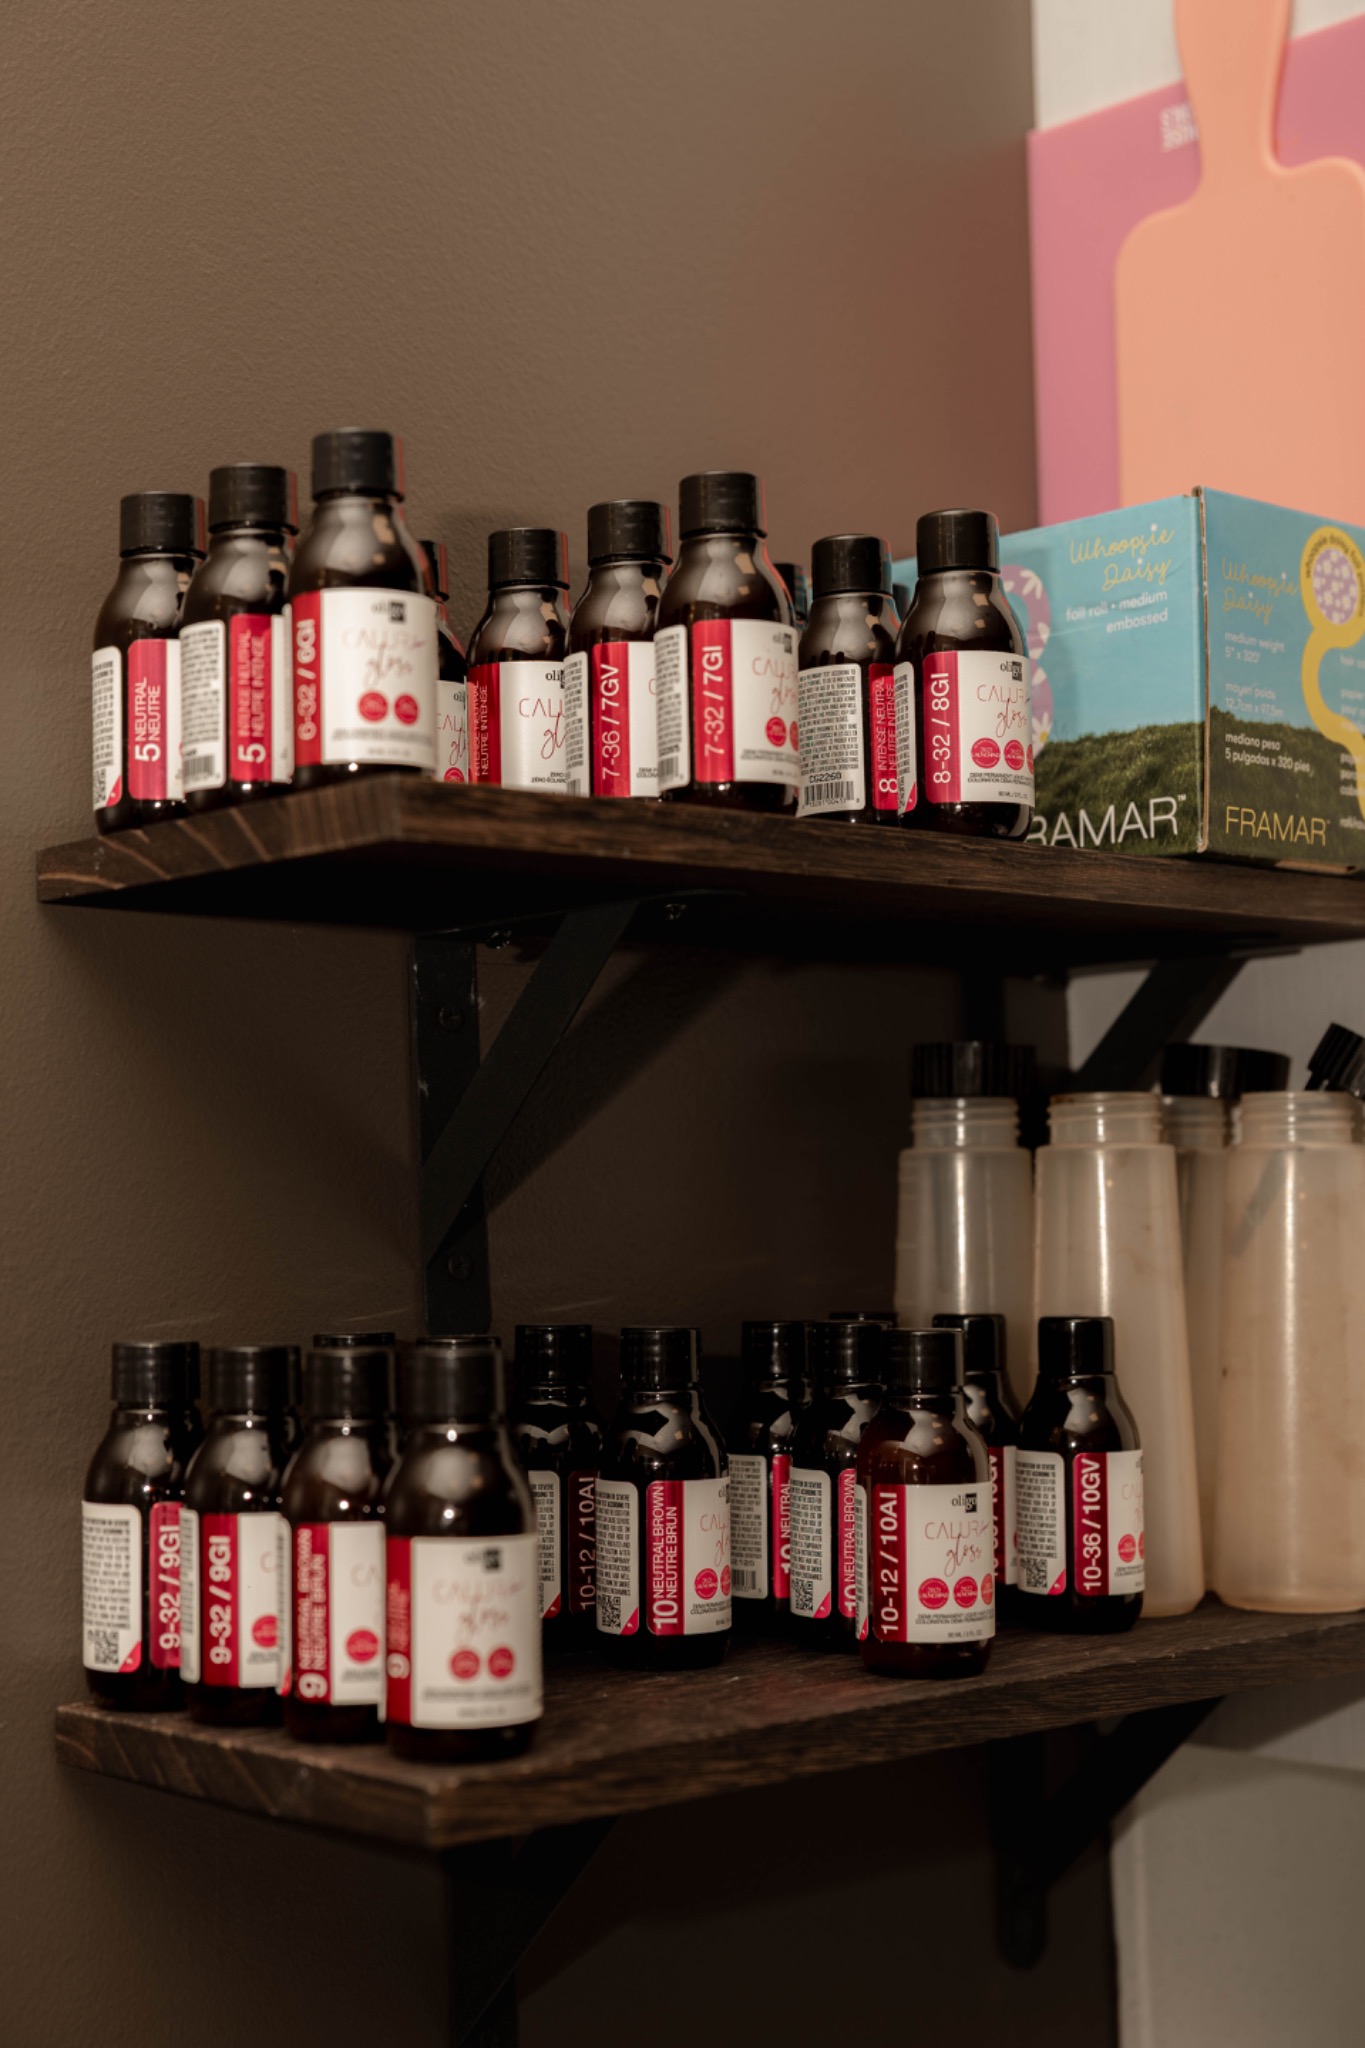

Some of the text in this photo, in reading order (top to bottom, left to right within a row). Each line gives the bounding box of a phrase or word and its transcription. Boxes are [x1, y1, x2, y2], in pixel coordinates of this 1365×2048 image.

[1066, 590, 1168, 621] foil roll medium
[1106, 607, 1168, 634] embossed
[600, 663, 620, 712] 7GV
[702, 645, 723, 683] 7GI
[134, 677, 147, 741] NEUTRAL
[148, 684, 161, 741] NEUTRE
[875, 676, 885, 724] NEUTRAL
[134, 743, 161, 762] 5
[703, 706, 725, 757] 7-32
[930, 672, 951, 784] 8-32 / 8GI
[238, 743, 267, 764] 5
[602, 730, 621, 780] 7-36
[878, 778, 898, 794] 8
[1225, 805, 1326, 847] FRAMAR
[579, 1477, 595, 1526] 10AI
[1081, 1458, 1102, 1591] 10-36 / 10GV
[159, 1525, 181, 1568] 9GI
[653, 1486, 665, 1598] NEUTRAL BROWN
[844, 1473, 855, 1582] NEUTRAL BROWN
[208, 1535, 232, 1583] 9GI
[666, 1507, 678, 1598] NEUTRE BRUN
[880, 1491, 899, 1634] 10-12 / 10AI
[579, 1548, 596, 1611] 10-12
[159, 1592, 181, 1650] 9-32
[208, 1604, 232, 1665] 9-32
[653, 1600, 678, 1629] 10
[298, 1673, 328, 1699] 9
